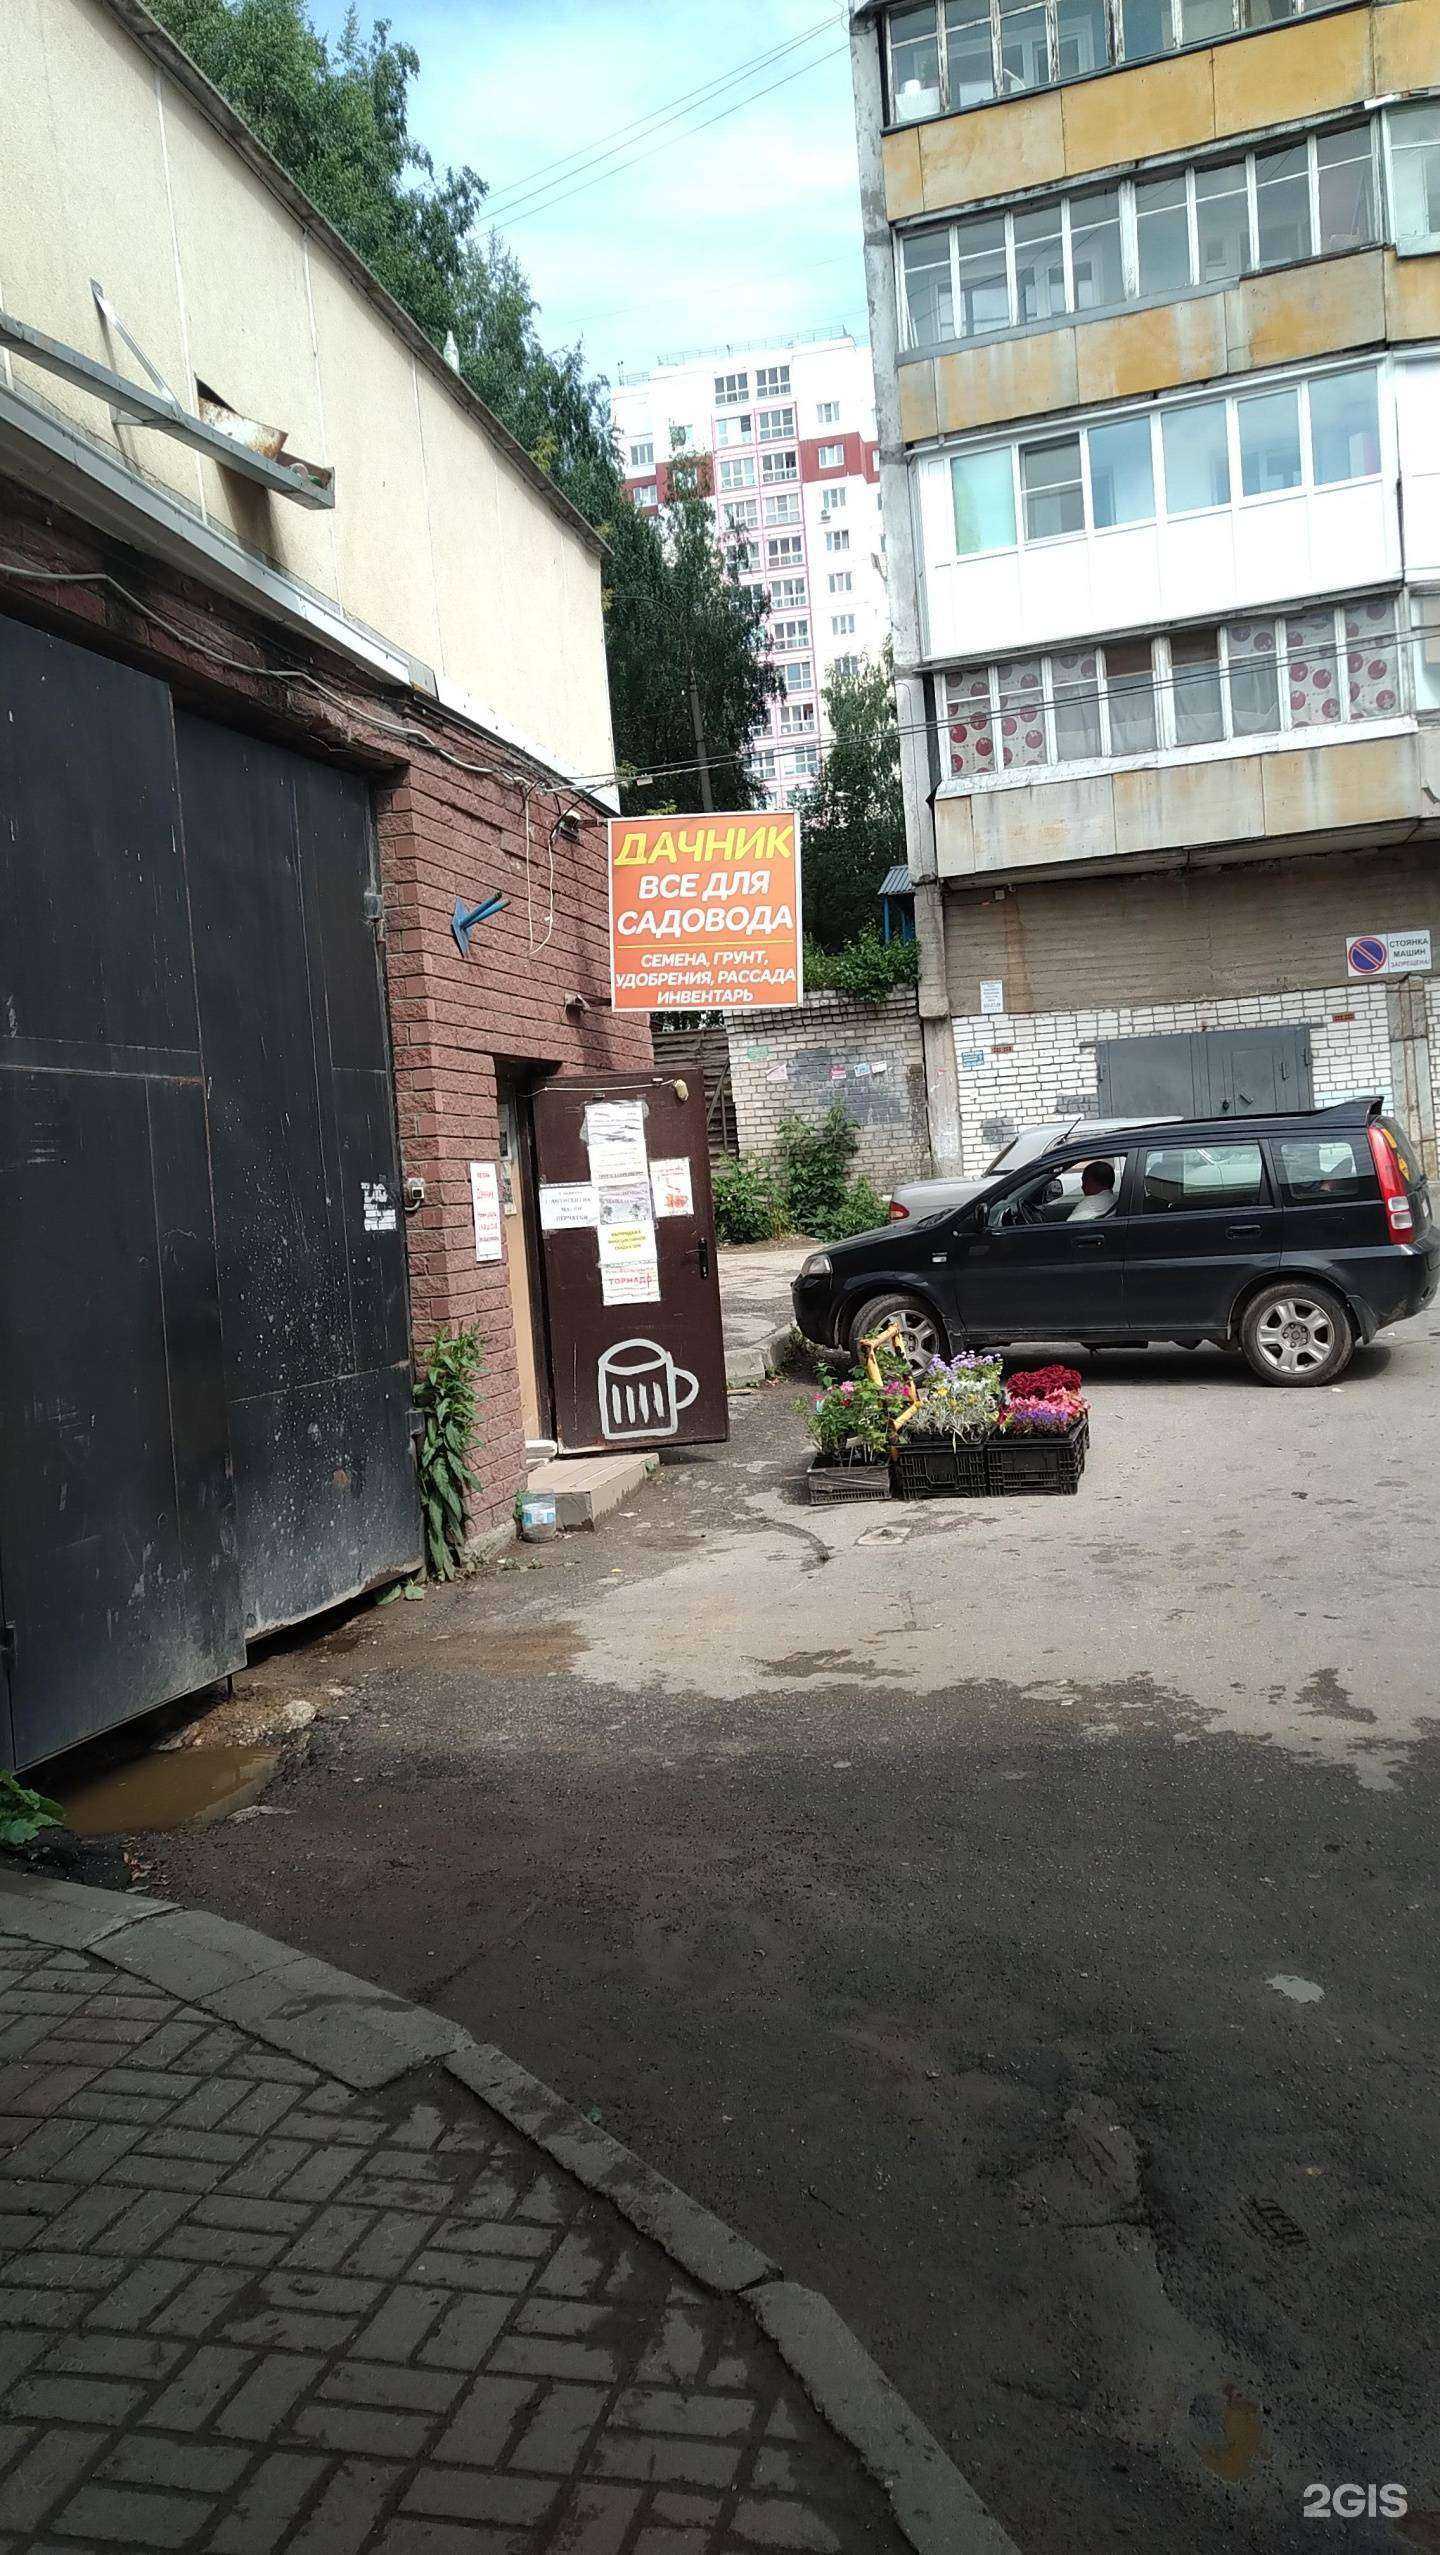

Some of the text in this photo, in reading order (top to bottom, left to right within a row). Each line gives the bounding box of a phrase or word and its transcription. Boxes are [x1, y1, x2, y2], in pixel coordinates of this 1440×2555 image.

[614, 824, 794, 866] ДАЧНИК
[638, 870, 771, 902] ВСЕ ДЛЯ
[617, 904, 794, 938] САДОВОДА
[1389, 937, 1429, 948] СТОЯНКА
[641, 950, 769, 968] СЕМЕНА, ГРУНТ,
[1393, 948, 1426, 958] МАШИН
[616, 967, 796, 989] УДОБРЕНИЯ, РАССАДА
[657, 988, 754, 1005] ИНВЕНТАРЬ
